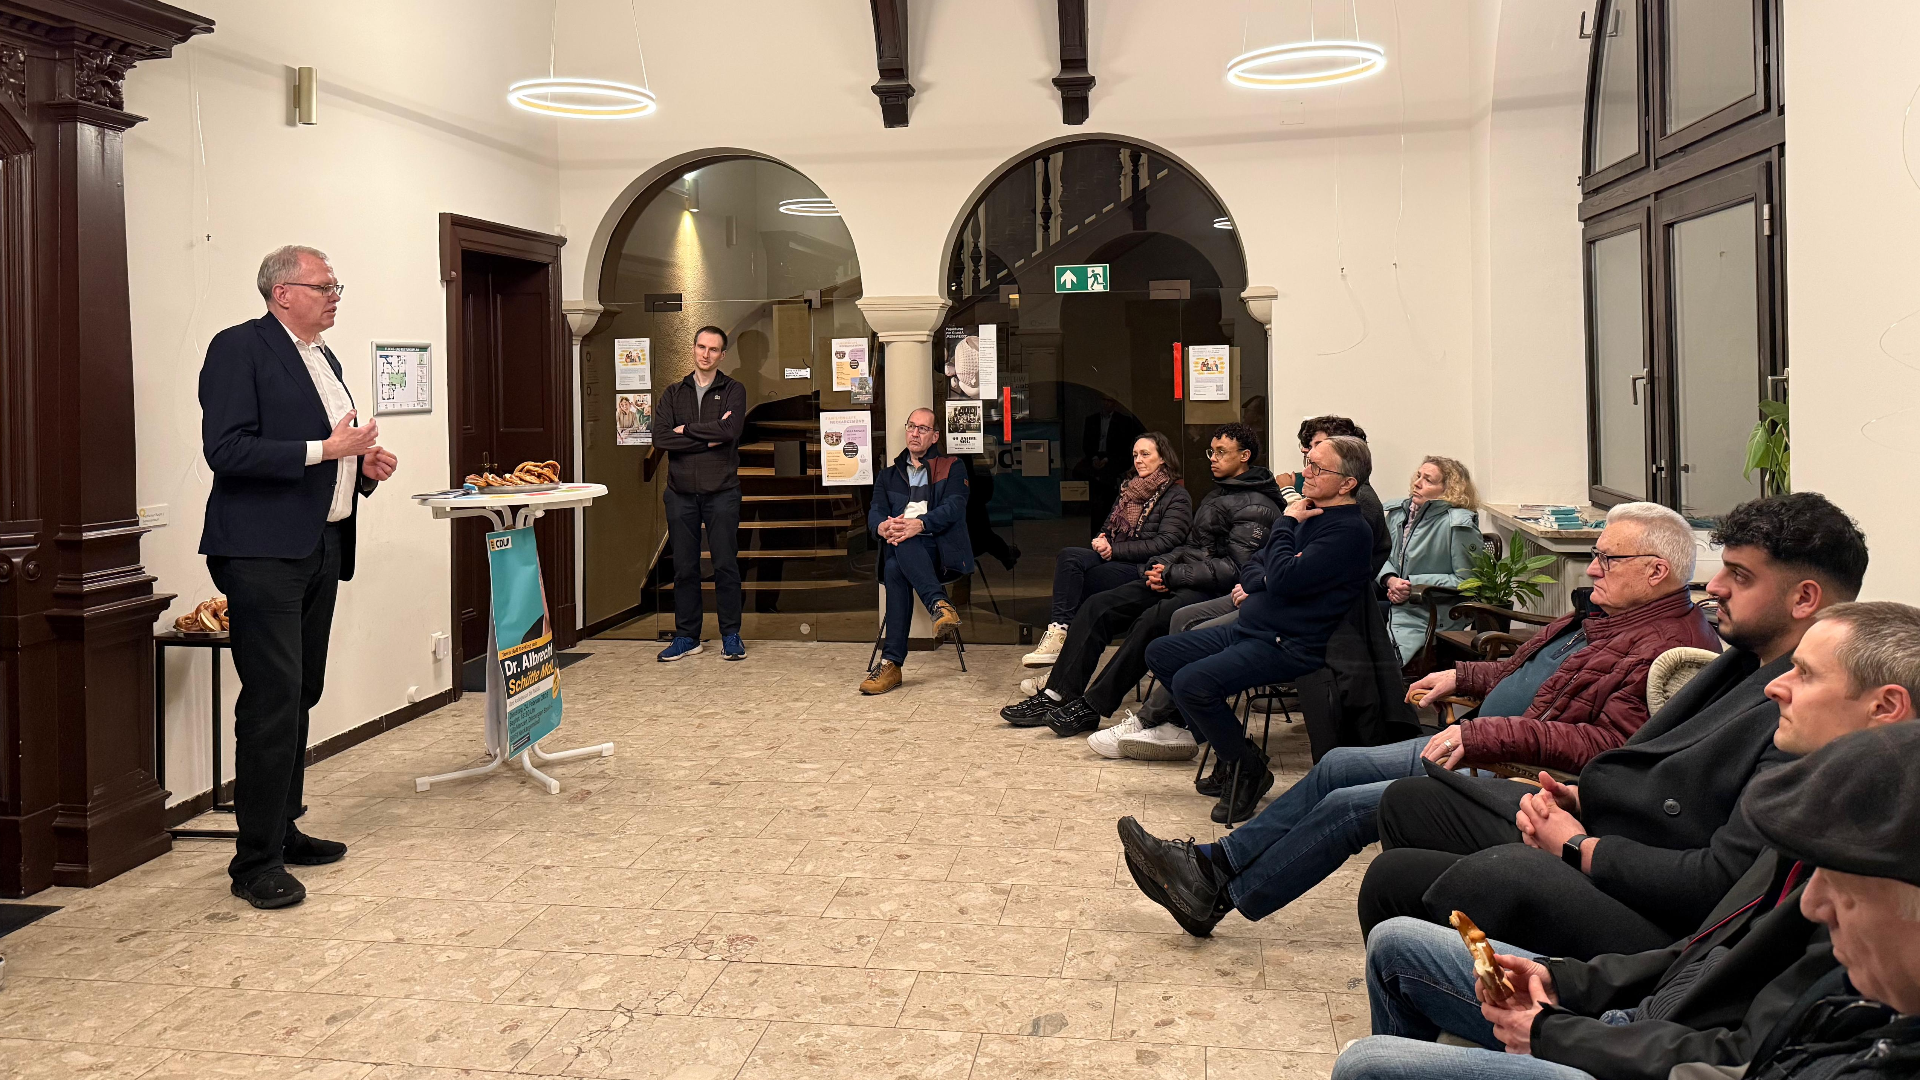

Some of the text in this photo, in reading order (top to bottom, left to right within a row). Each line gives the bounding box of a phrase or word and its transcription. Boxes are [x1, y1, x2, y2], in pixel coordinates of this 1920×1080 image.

[495, 538, 509, 548] CDU
[504, 660, 520, 676] Dr.
[508, 670, 540, 695] Schütte
